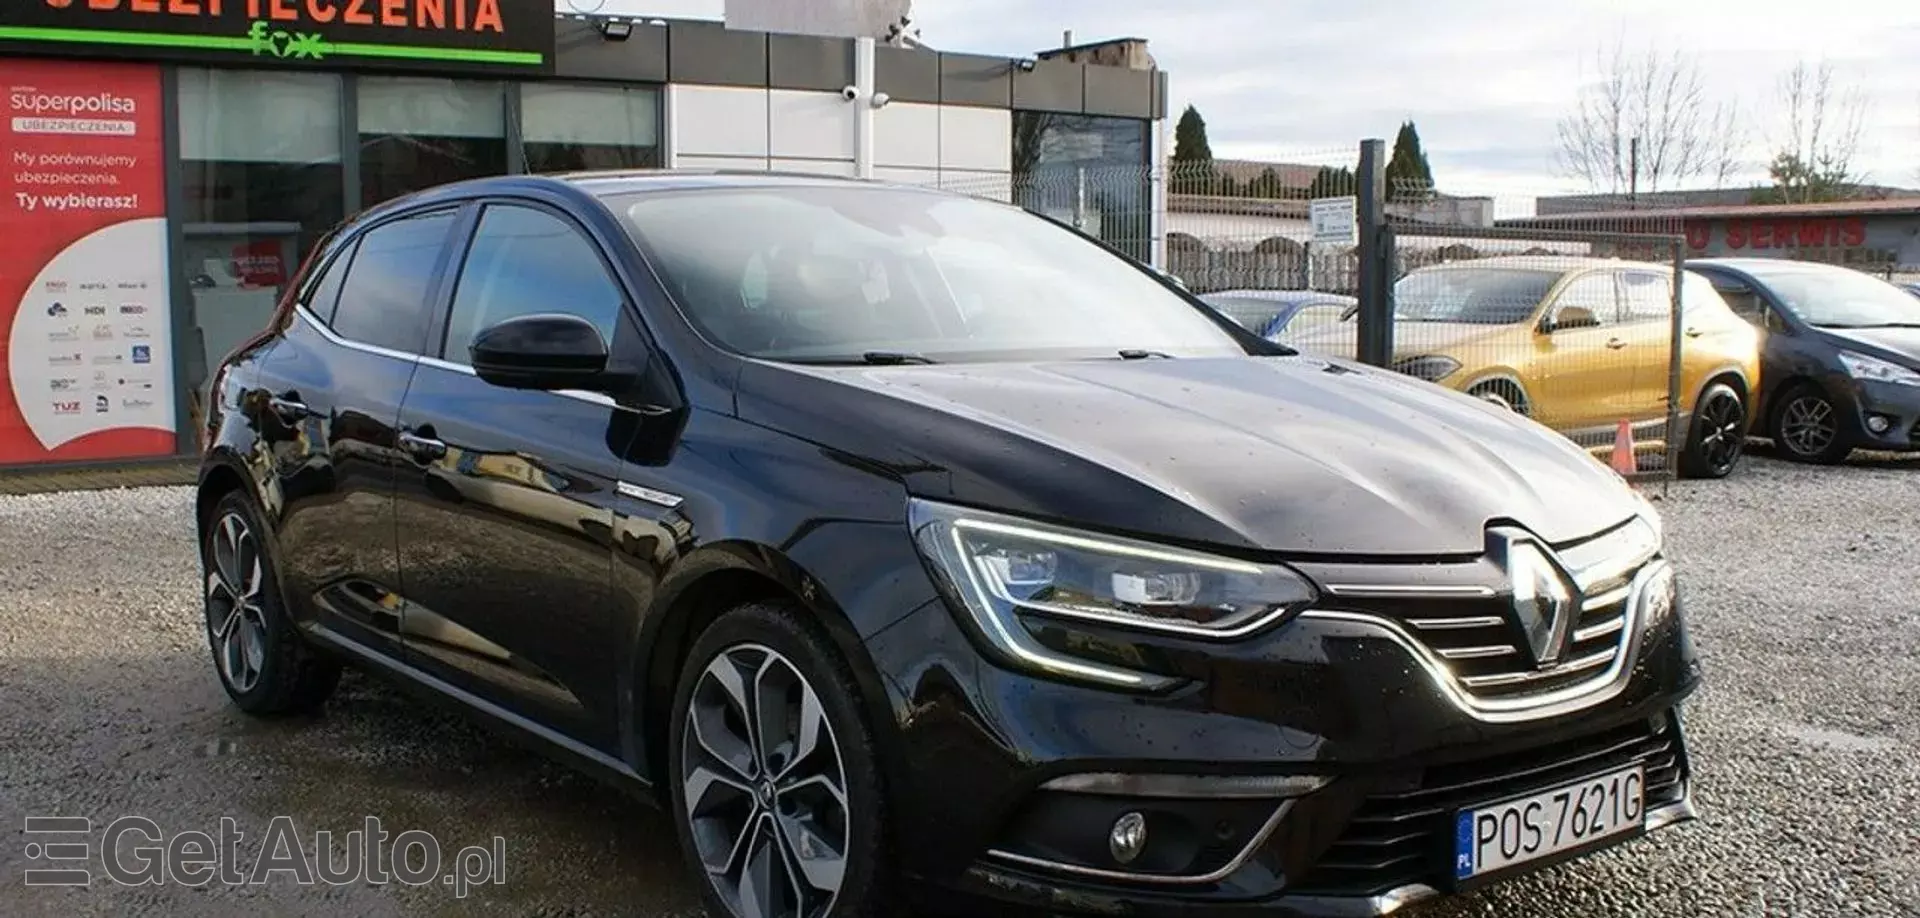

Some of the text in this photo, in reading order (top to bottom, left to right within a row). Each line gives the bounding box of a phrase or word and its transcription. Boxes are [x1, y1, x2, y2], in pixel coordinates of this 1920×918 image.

[47, 0, 504, 33] IECZENIA
[11, 93, 136, 116] superpolisa
[22, 120, 126, 132] UBEZPIECZENIA
[14, 152, 137, 168] My porównujemy
[15, 171, 121, 185] ubezpieczenia.
[16, 192, 138, 211] Ty wybierasz!
[1726, 216, 1867, 250] SERWIS
[1477, 772, 1641, 868] POS 7621G
[1456, 853, 1471, 868] PL
